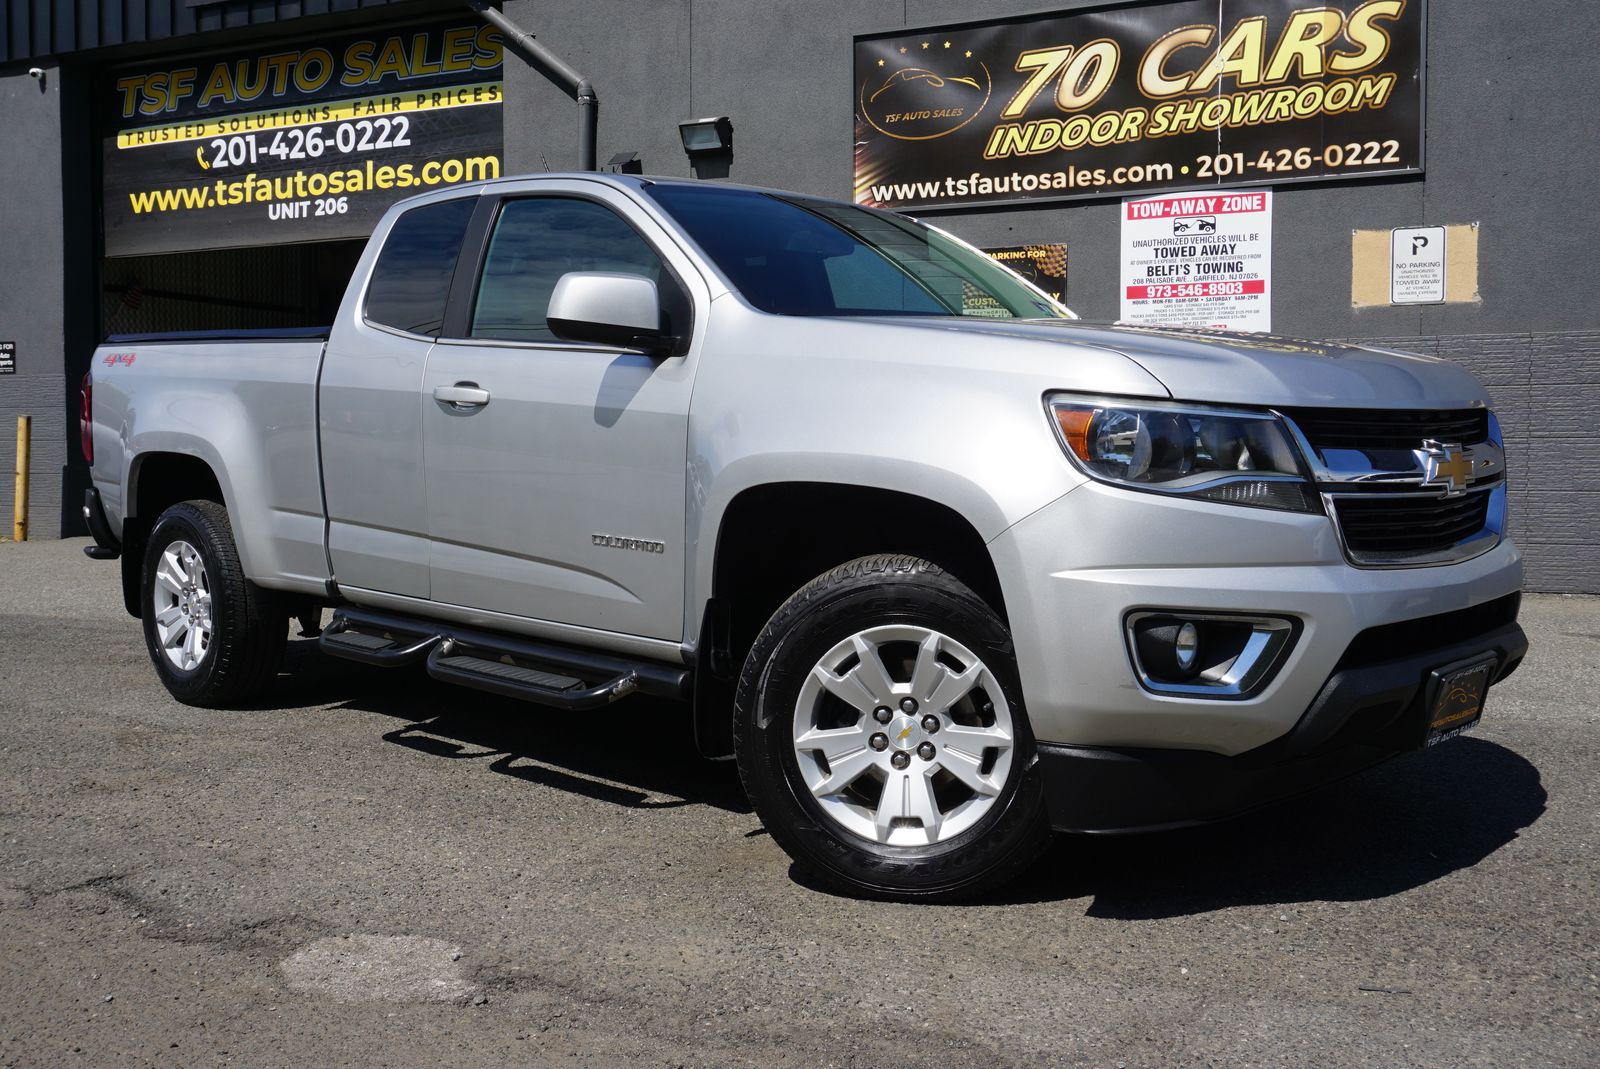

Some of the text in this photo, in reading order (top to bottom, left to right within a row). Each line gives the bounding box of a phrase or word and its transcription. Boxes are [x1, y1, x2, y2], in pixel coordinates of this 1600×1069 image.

[117, 24, 503, 118] TSF AUTO SALES
[1000, 0, 1405, 120] 70 CARS
[126, 85, 498, 145] TRUSTED SOLUTIONS, FAIR PRICES
[885, 108, 964, 123] TSF AUTO SALES
[984, 73, 1396, 160] INDOOR SHOWROOM
[211, 116, 411, 168] 201-426-0222
[871, 139, 1400, 202] www.tsfautosales.com 201-426-0222
[130, 153, 499, 214] www.tsfautosales.com
[268, 197, 348, 220] UNIT 206
[1131, 195, 1262, 218] TOW-AWAY ZONE
[1133, 233, 1259, 248] UNAUTHORIZED VEHICLES WILL BE
[1153, 244, 1237, 259] TOWED AWAY
[1027, 250, 1046, 258] FOR
[1147, 261, 1243, 277] BELFI'S TOWING
[1147, 282, 1243, 298] 973-546-8903
[591, 534, 664, 554] COLORADO
